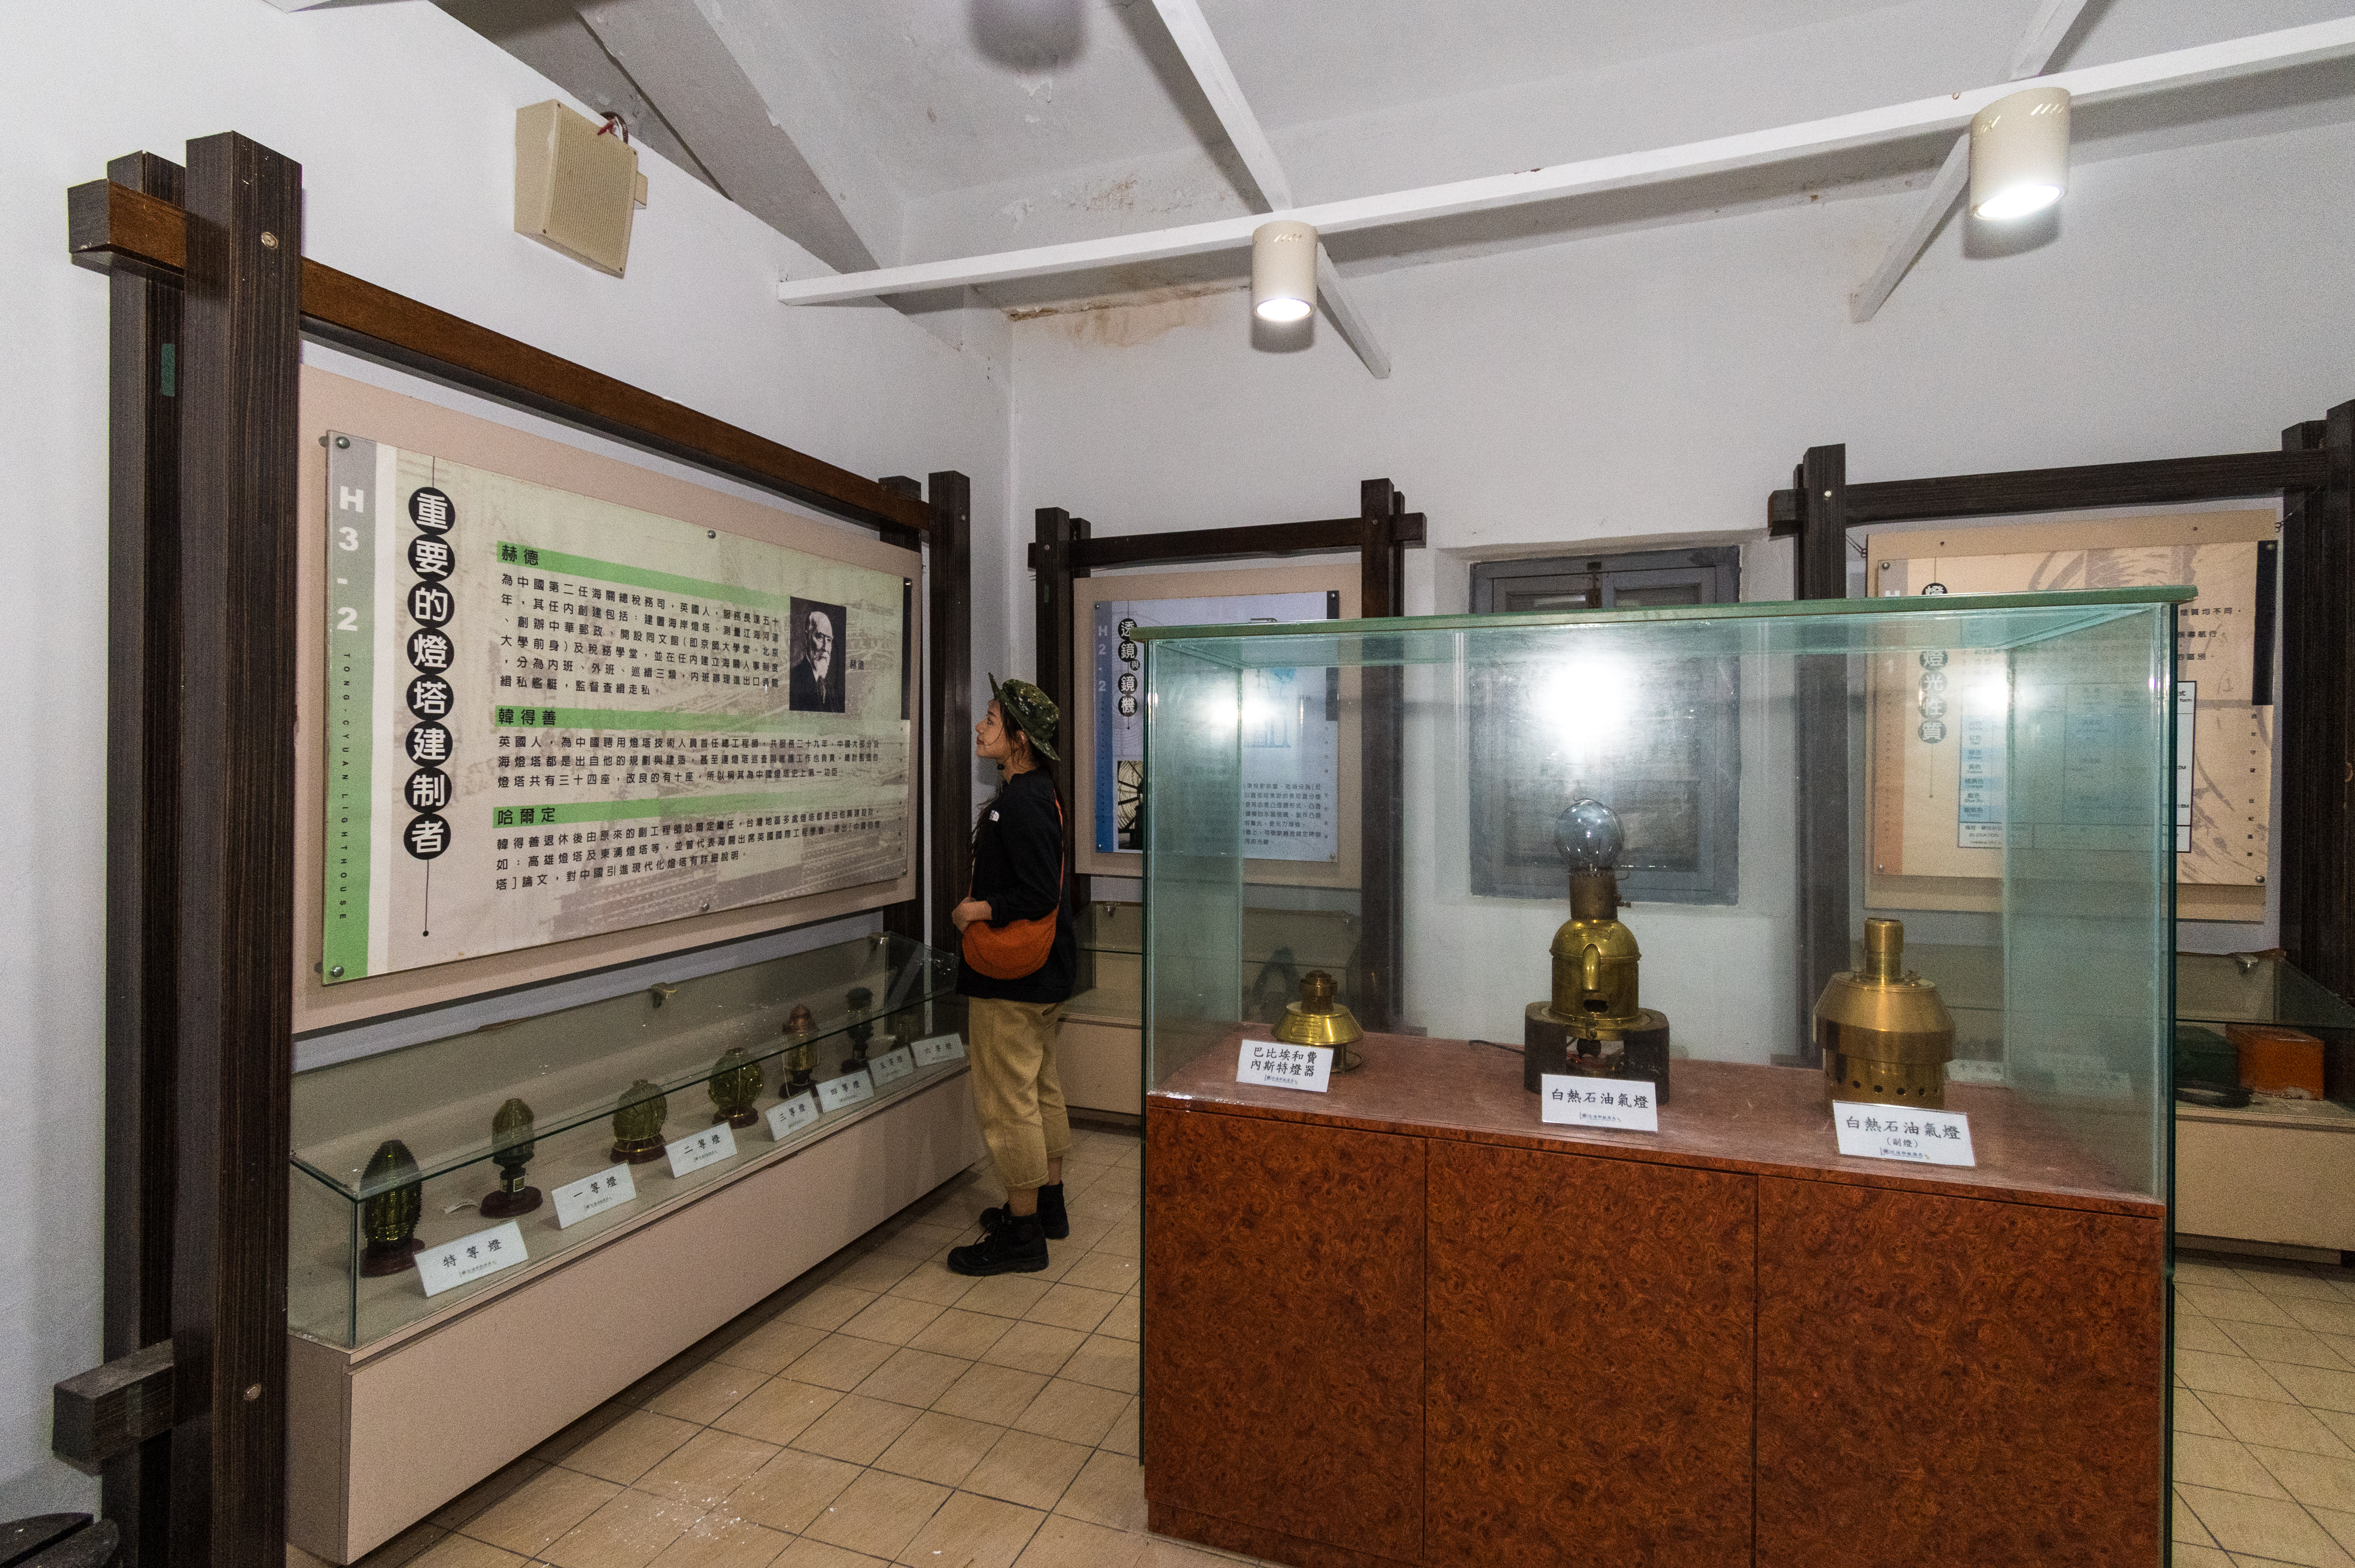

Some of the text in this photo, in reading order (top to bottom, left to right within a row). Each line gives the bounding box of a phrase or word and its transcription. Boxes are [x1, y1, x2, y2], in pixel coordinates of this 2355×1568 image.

[502, 544, 539, 566] 赫德
[411, 492, 448, 854] 重要的燈塔建制者
[500, 675, 660, 696] 緝私艦艇，監督查緝走私。
[498, 708, 557, 726] 韓得善
[497, 807, 556, 826] 哈爾定
[340, 793, 349, 919] LIGHTHOUSE
[1254, 1047, 1317, 1065] 巴比埃和費
[830, 1080, 861, 1095] 四等燈
[1552, 1088, 1649, 1108] 白熱石油氣燈
[779, 1103, 806, 1122] 三等燈
[1846, 1116, 1961, 1140] 白熱石油氣燈
[684, 1134, 721, 1154] 二等燈
[573, 1176, 617, 1197] 一等燈
[443, 1239, 502, 1268] 特等燈
